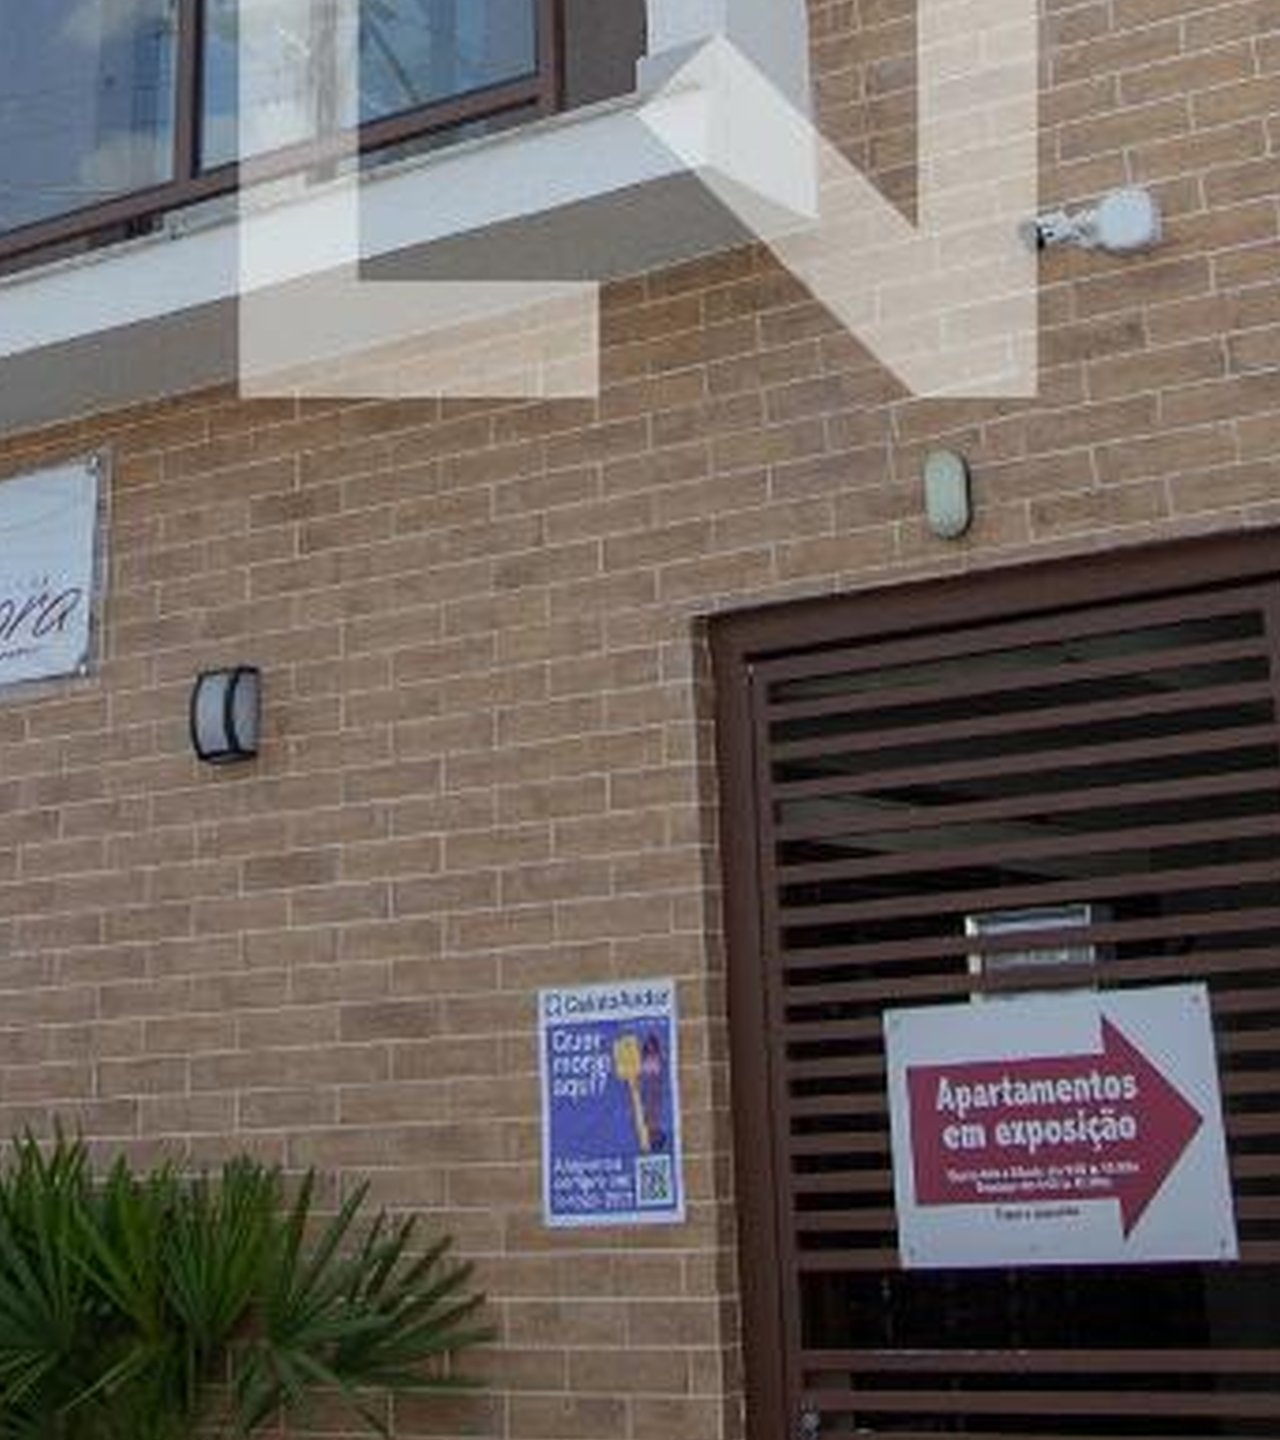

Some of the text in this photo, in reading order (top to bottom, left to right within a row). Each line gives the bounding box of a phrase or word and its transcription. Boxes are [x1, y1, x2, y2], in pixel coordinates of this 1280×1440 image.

[936, 1072, 1138, 1118] Apartamentos
[942, 1108, 1137, 1154] em exposição
